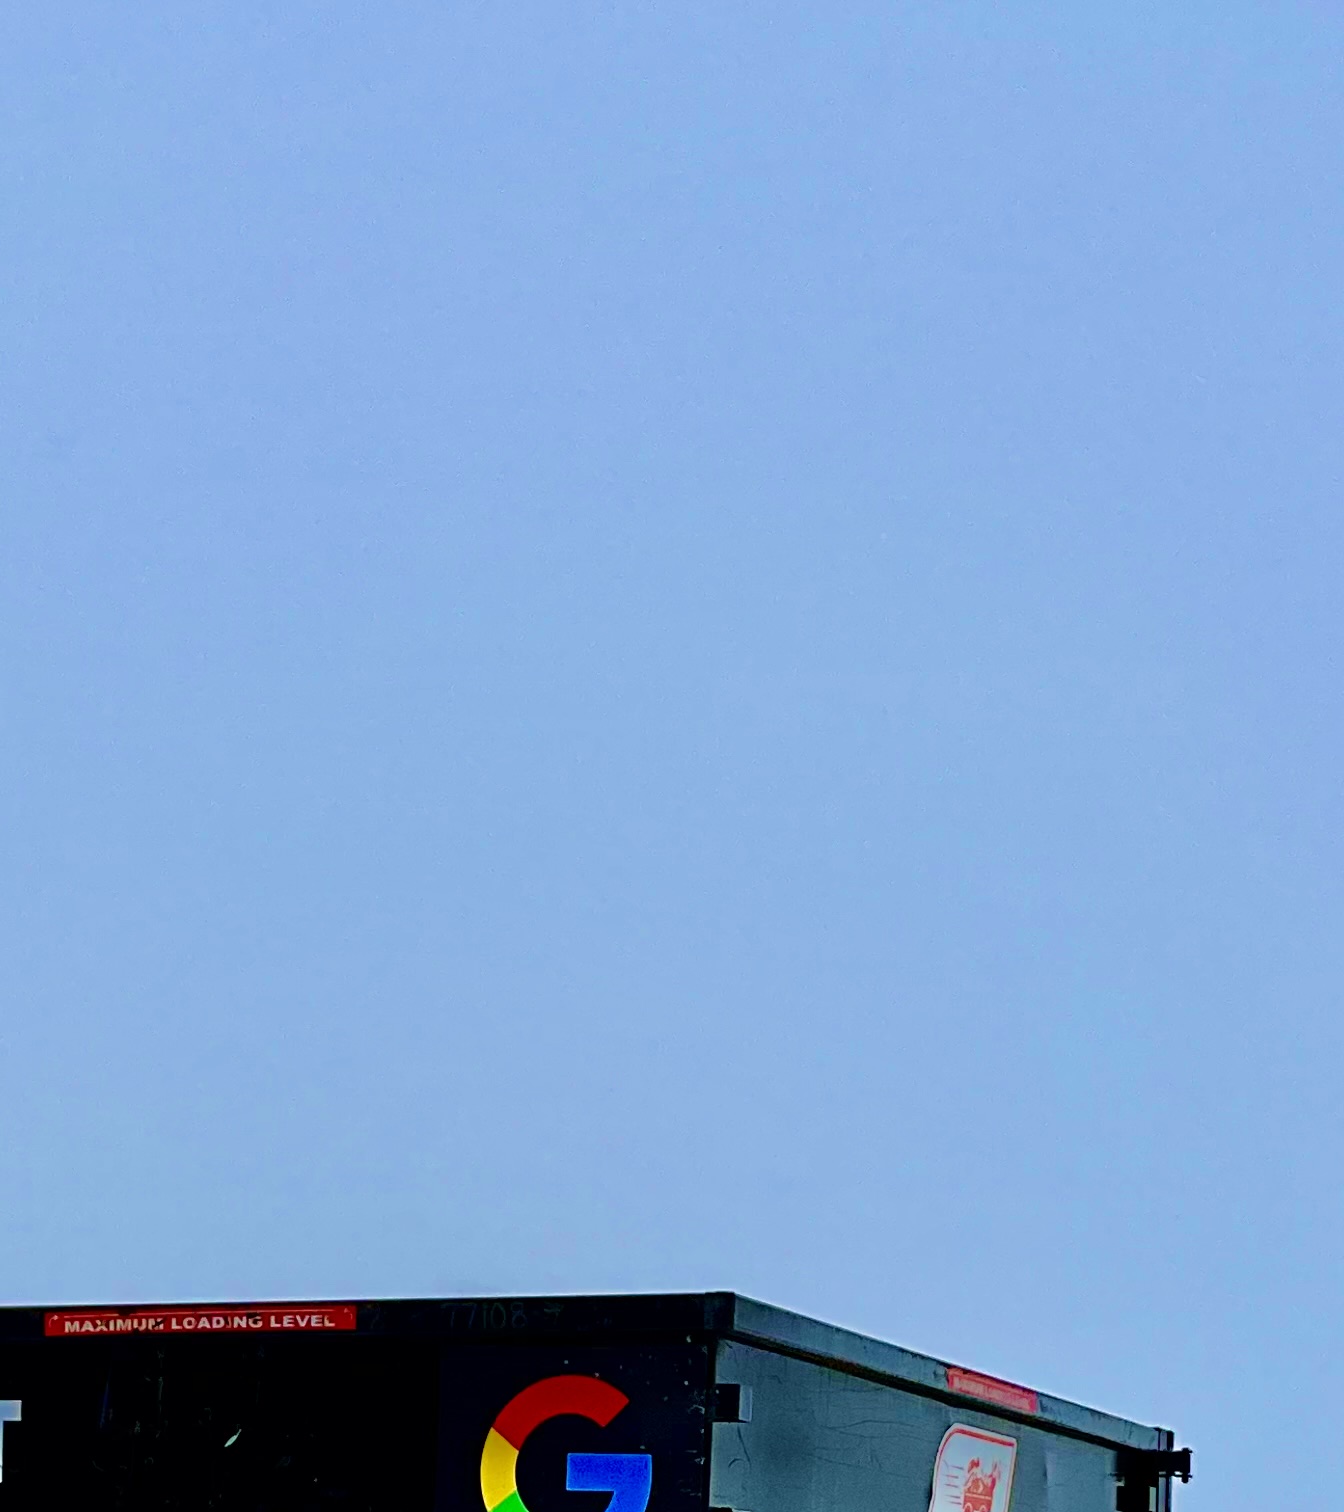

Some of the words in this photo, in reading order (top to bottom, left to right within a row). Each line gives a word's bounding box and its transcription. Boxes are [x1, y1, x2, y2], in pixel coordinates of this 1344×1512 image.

[64, 1316, 164, 1334] MAXIMUM
[171, 1315, 264, 1331] LOADING
[270, 1314, 336, 1329] LEVEL
